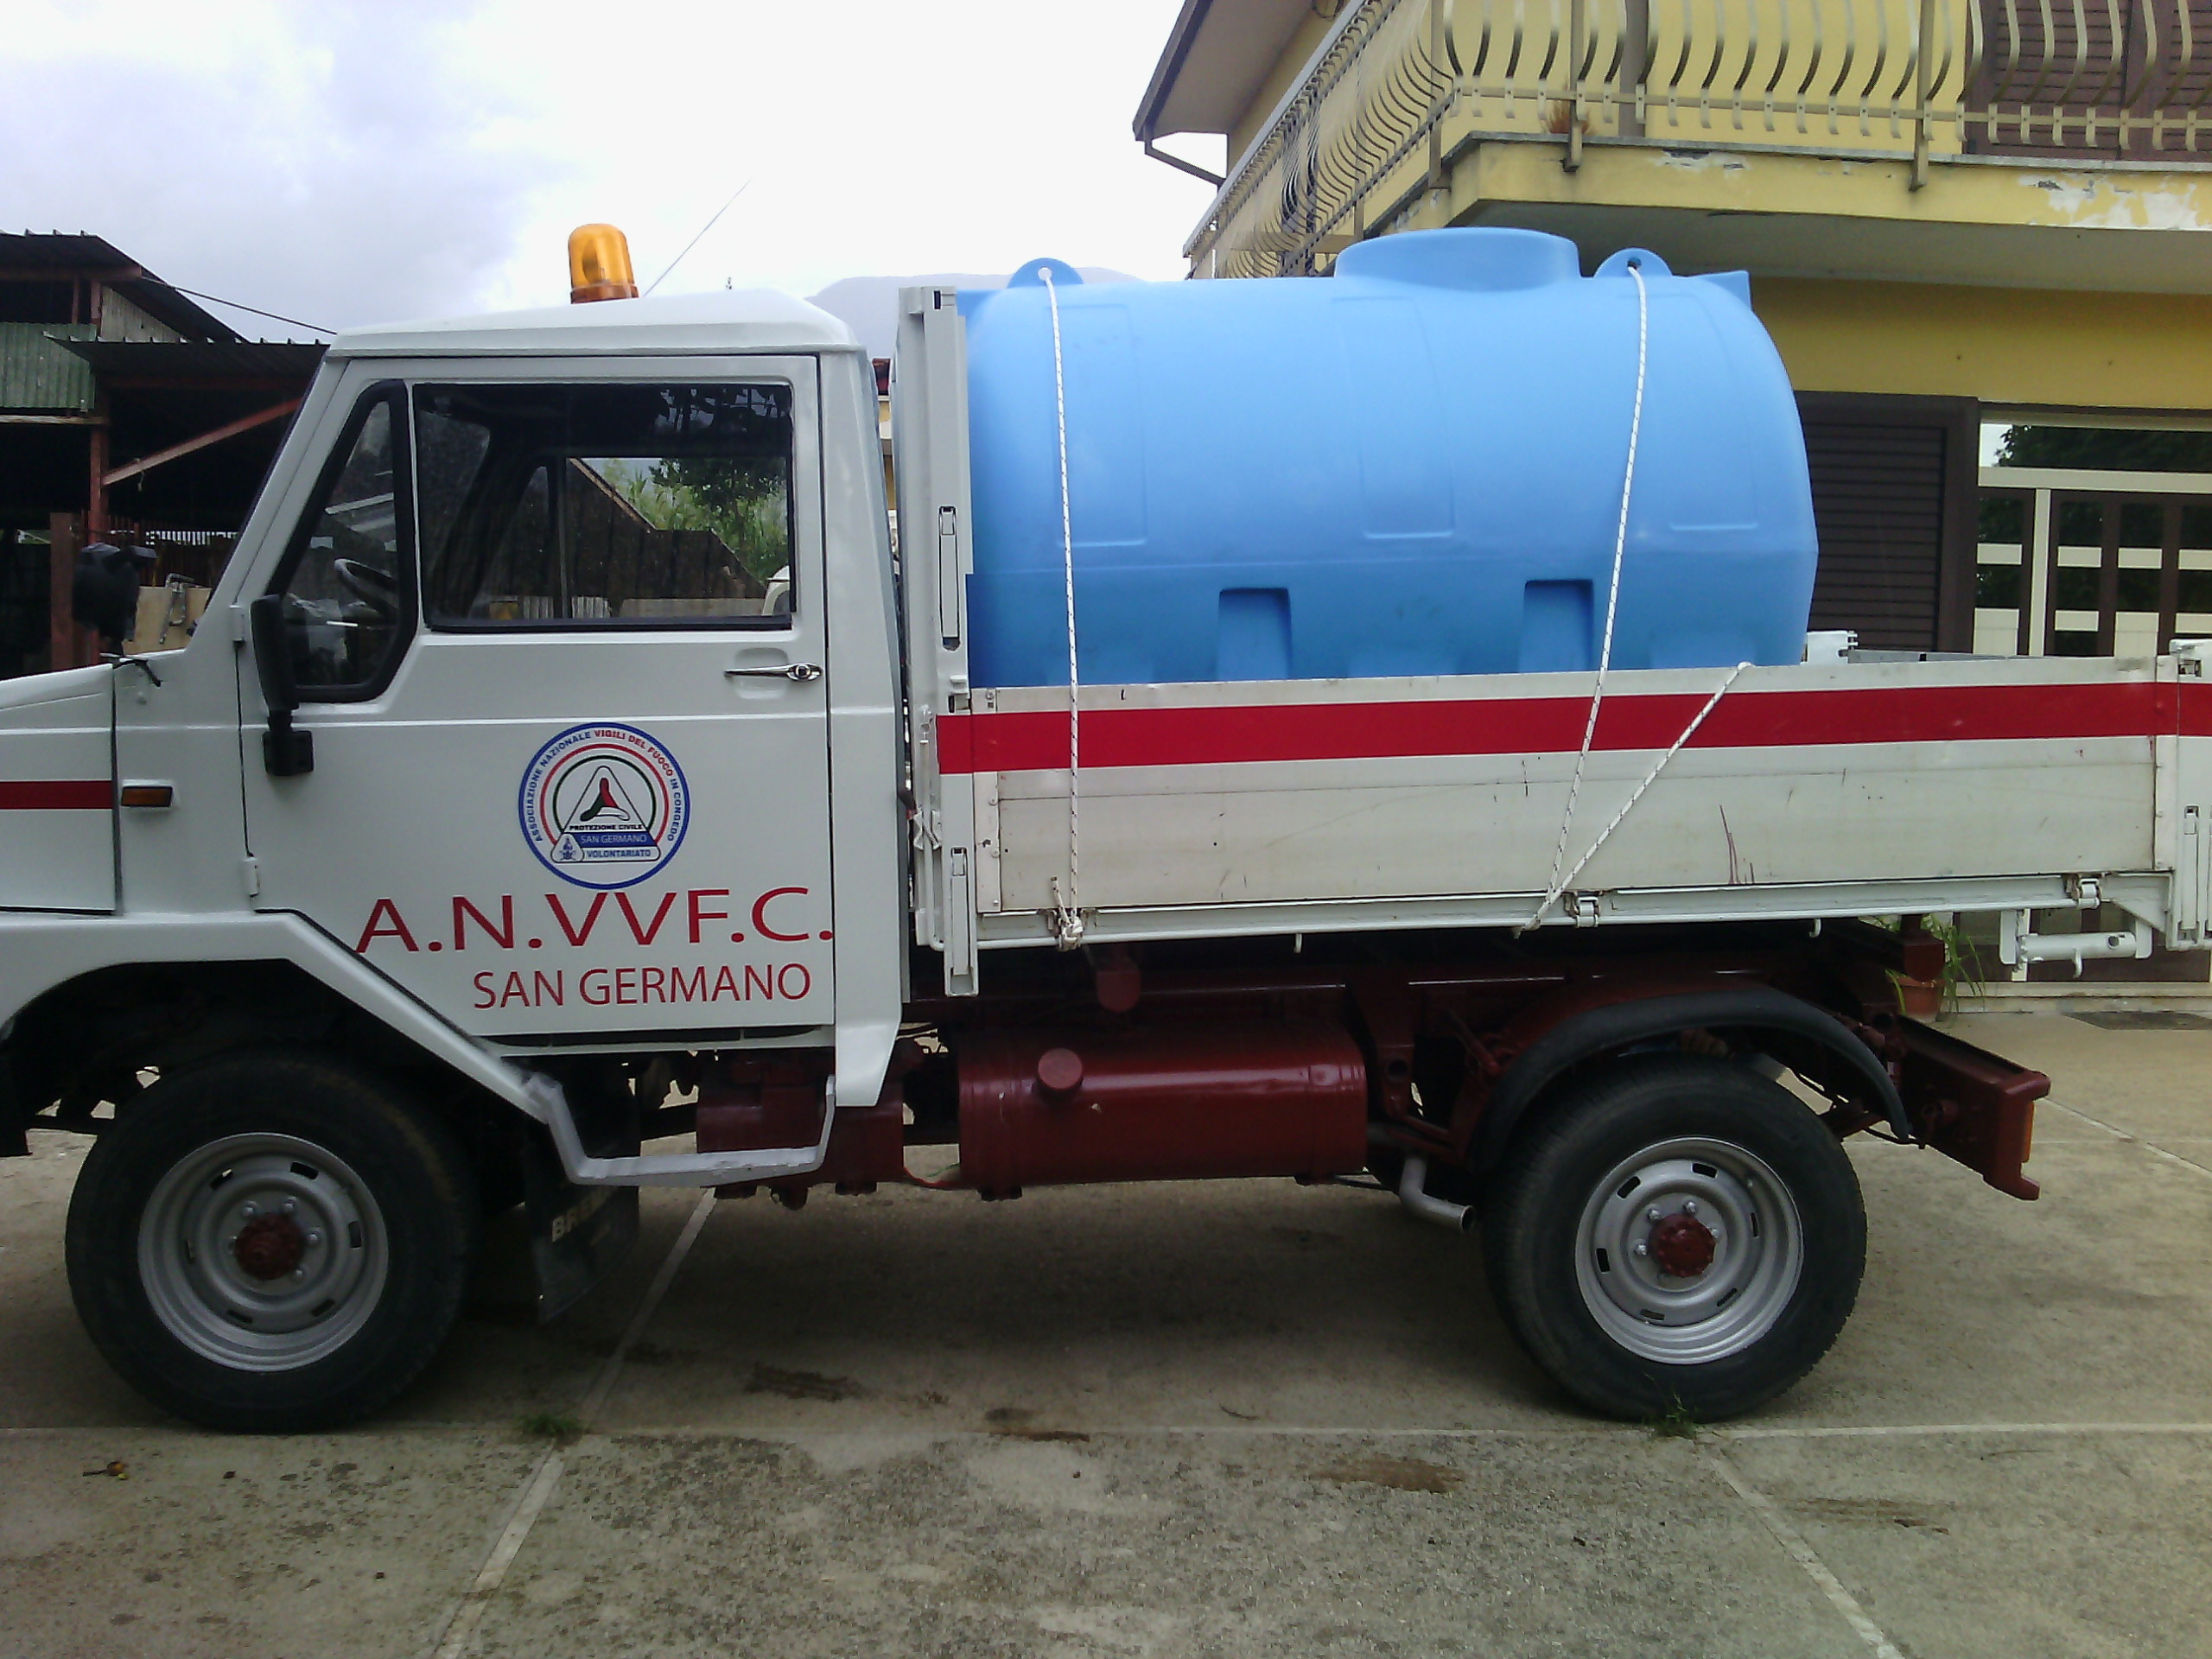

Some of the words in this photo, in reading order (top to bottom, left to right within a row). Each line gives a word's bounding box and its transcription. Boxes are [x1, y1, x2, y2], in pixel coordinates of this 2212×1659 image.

[594, 729, 626, 741] VIGILI
[627, 734, 646, 750] DEL
[540, 731, 591, 767] NAZIONALE
[647, 747, 673, 777] FUOCO
[670, 779, 680, 790] IN
[526, 769, 543, 842] ASSOCIAZIONE
[667, 791, 682, 842] CONGEDO
[601, 834, 647, 843] GERMANO
[587, 849, 652, 859] VOLONTARIATO
[474, 969, 564, 1009] SAN
[579, 963, 811, 1006] GERMANO
